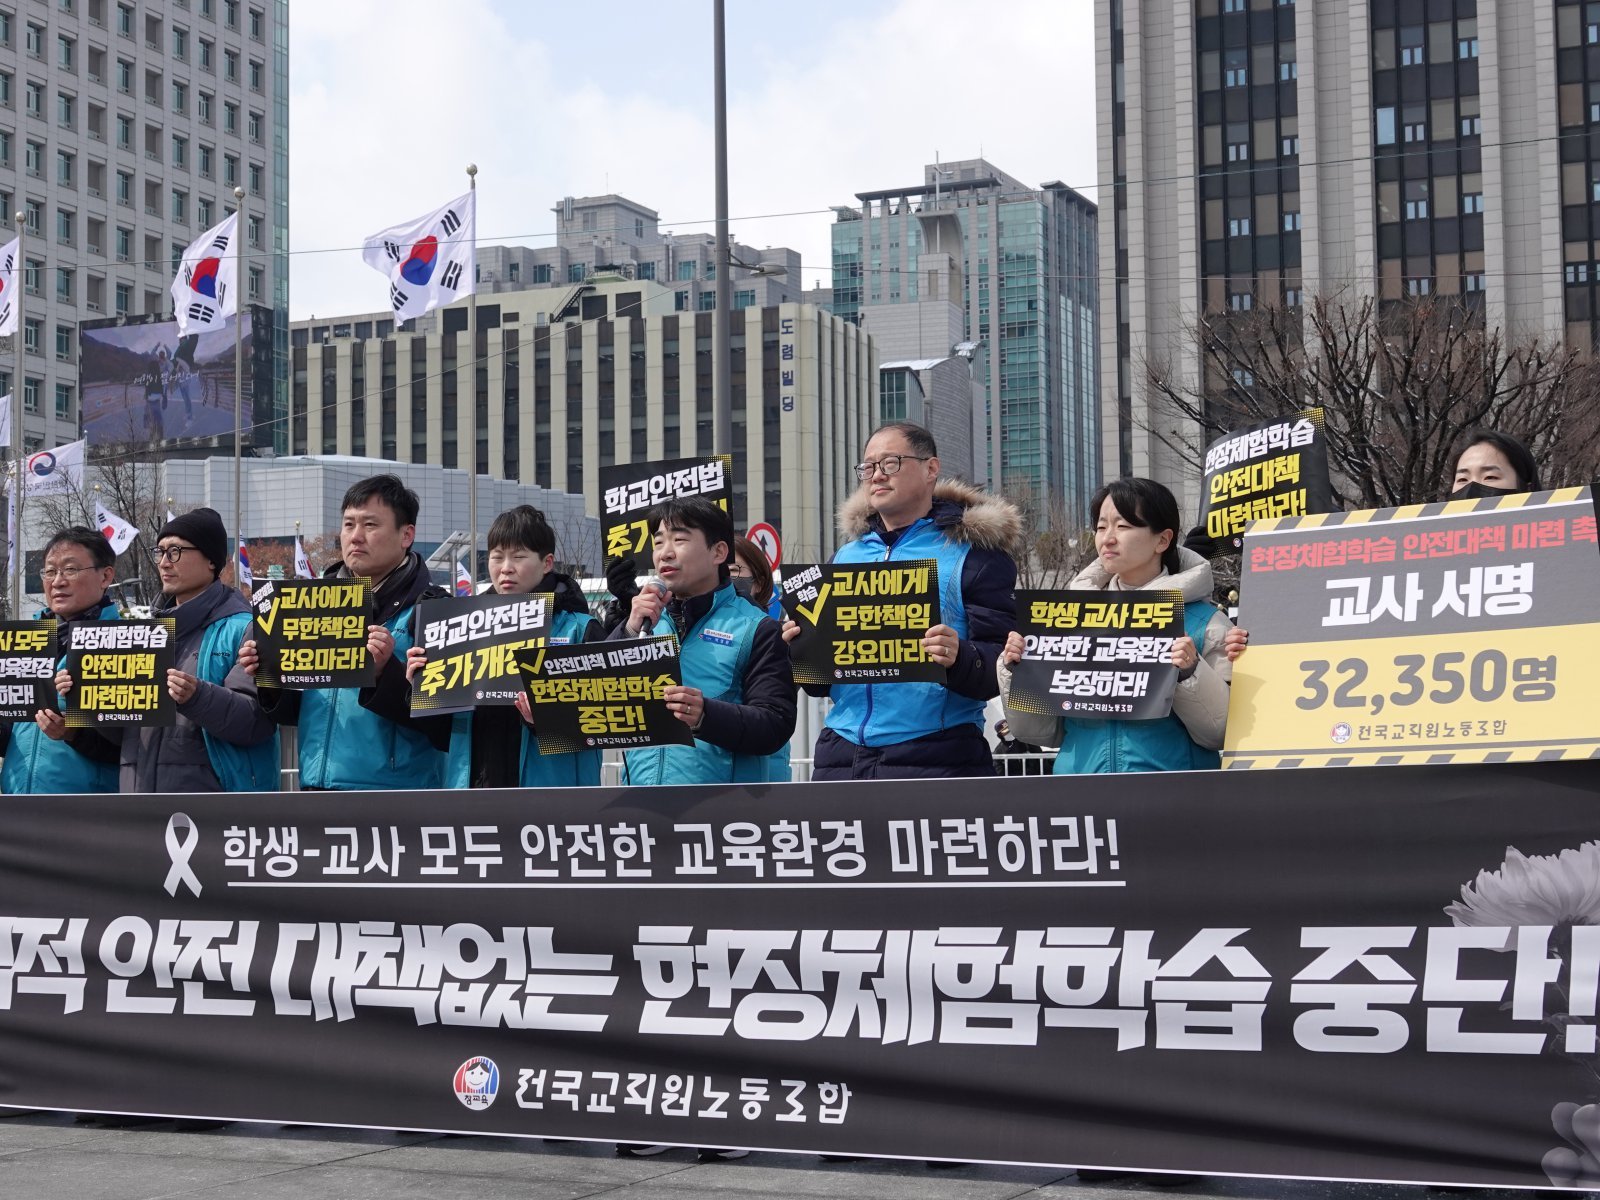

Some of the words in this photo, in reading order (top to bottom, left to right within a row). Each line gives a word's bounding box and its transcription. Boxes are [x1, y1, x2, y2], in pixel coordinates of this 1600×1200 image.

[781, 319, 794, 412] 도렴빌딩
[1205, 418, 1315, 474] 현장체험학습
[604, 460, 724, 515] 학교안전법
[1210, 453, 1301, 504] 안전대책
[1251, 535, 1398, 573] 현장체험학습
[1403, 524, 1505, 561] 안전대책
[1512, 519, 1565, 549] 마련
[782, 564, 823, 595] 현장체험
[796, 585, 819, 602] 학습
[832, 568, 930, 597] 교사에게
[280, 586, 363, 609] 교사에게
[1321, 572, 1424, 627] 교사
[1432, 562, 1534, 619] 서명
[282, 615, 364, 641] 무한책임
[424, 599, 545, 650] 학교안전법
[836, 603, 931, 632] 무한책임
[1030, 602, 1080, 629] 학생
[1080, 602, 1130, 630] 교사
[1131, 602, 1175, 630] 모두
[14, 630, 49, 652] 모두
[71, 625, 168, 650] 현장체험학습
[1021, 635, 1091, 662] 안전한
[81, 654, 155, 680] 안전대책
[280, 647, 365, 671] 강요마라!
[543, 653, 607, 676] 안전대책
[609, 640, 676, 667] 마련까지
[420, 656, 473, 698] 추가
[844, 669, 900, 679] 전국교직원노동조합
[1049, 670, 1149, 698] 보장하라!
[1295, 649, 1557, 716] 32,350명
[80, 684, 159, 710] 마련하라!
[530, 674, 678, 704] 현장체험학습
[578, 705, 647, 734] 중단!
[1074, 702, 1133, 713] 전국교직원노동조합
[1357, 719, 1508, 741] 전국교직원노동조합
[223, 825, 405, 878] 학생-교사
[419, 825, 503, 878] 모두
[520, 821, 656, 878] 안전한
[673, 819, 868, 878] 교육환경
[889, 815, 1121, 876] 마련하라!
[98, 916, 260, 1017] 안전
[270, 920, 620, 1033] 대책없는
[632, 925, 1273, 1053] 현장체험학습
[1289, 925, 1599, 1055] 중단!
[515, 1068, 853, 1126] 전국교직원노동조합
